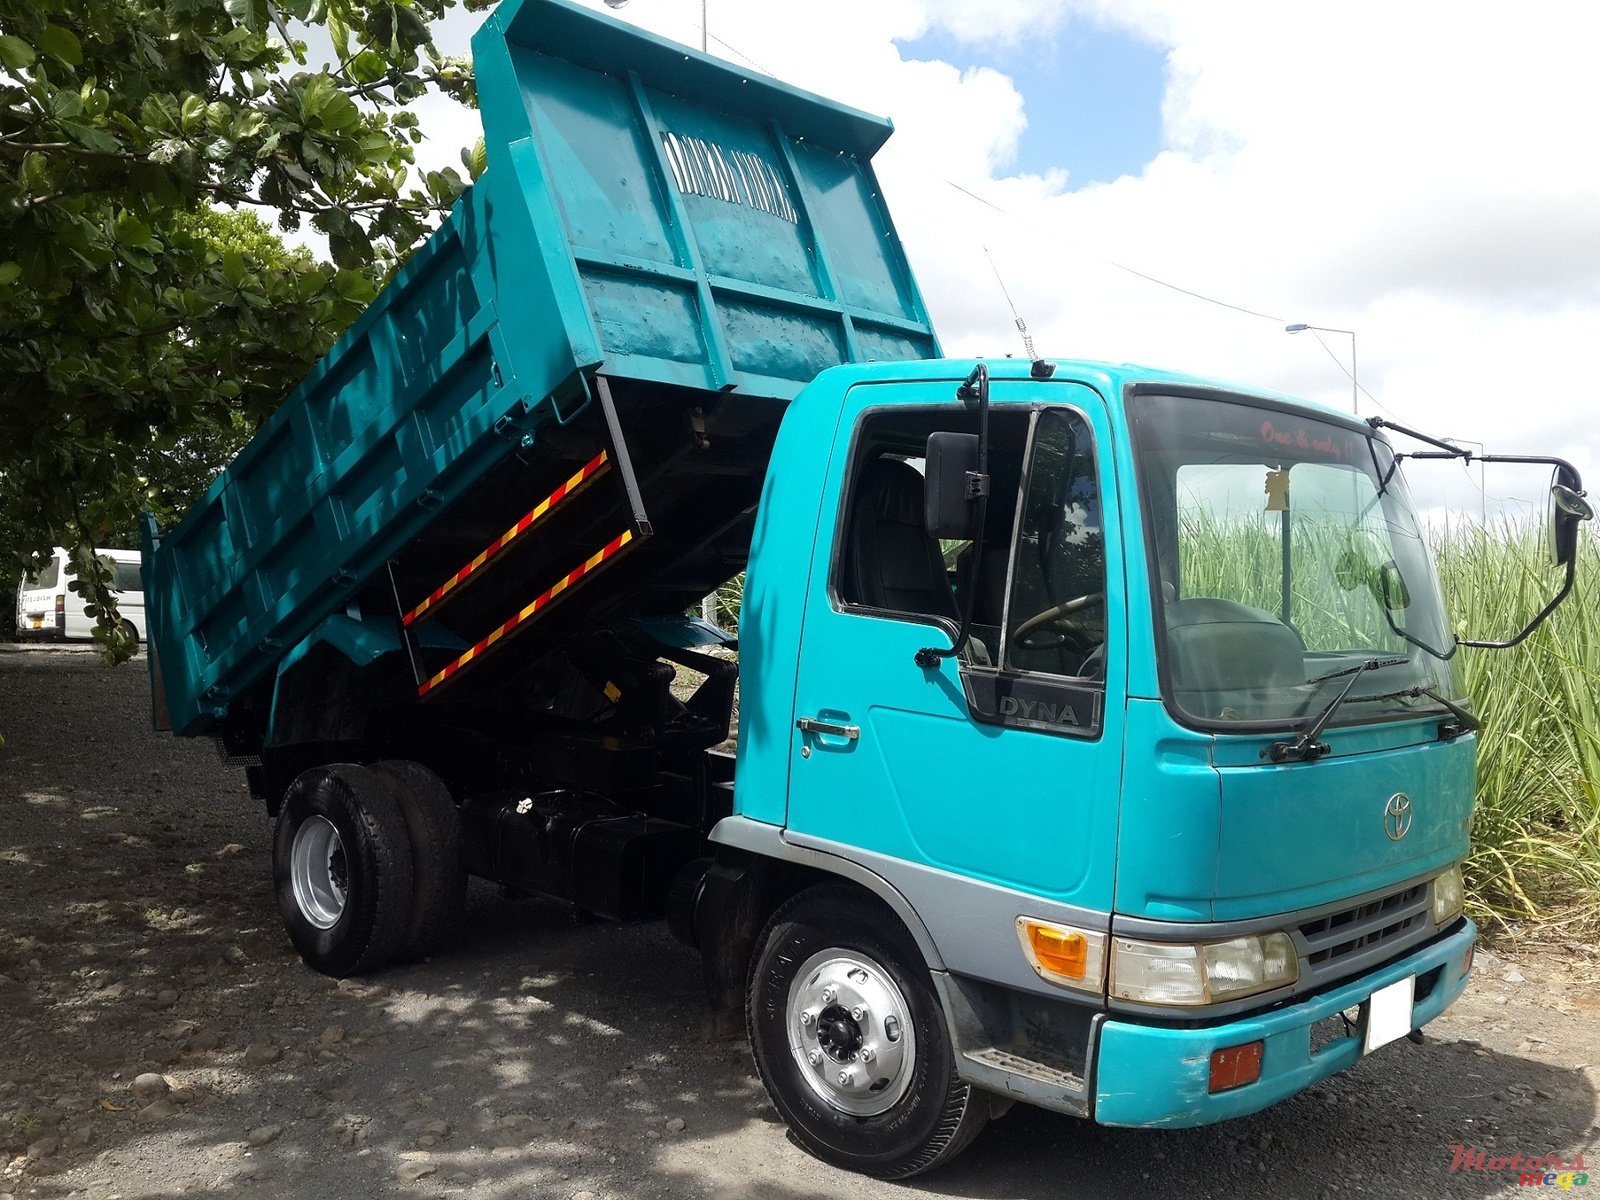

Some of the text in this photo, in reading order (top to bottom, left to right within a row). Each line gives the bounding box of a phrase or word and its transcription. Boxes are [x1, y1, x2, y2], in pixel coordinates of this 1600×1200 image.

[1260, 420, 1291, 446] One
[1312, 436, 1341, 459] only
[999, 695, 1079, 726] DYNA
